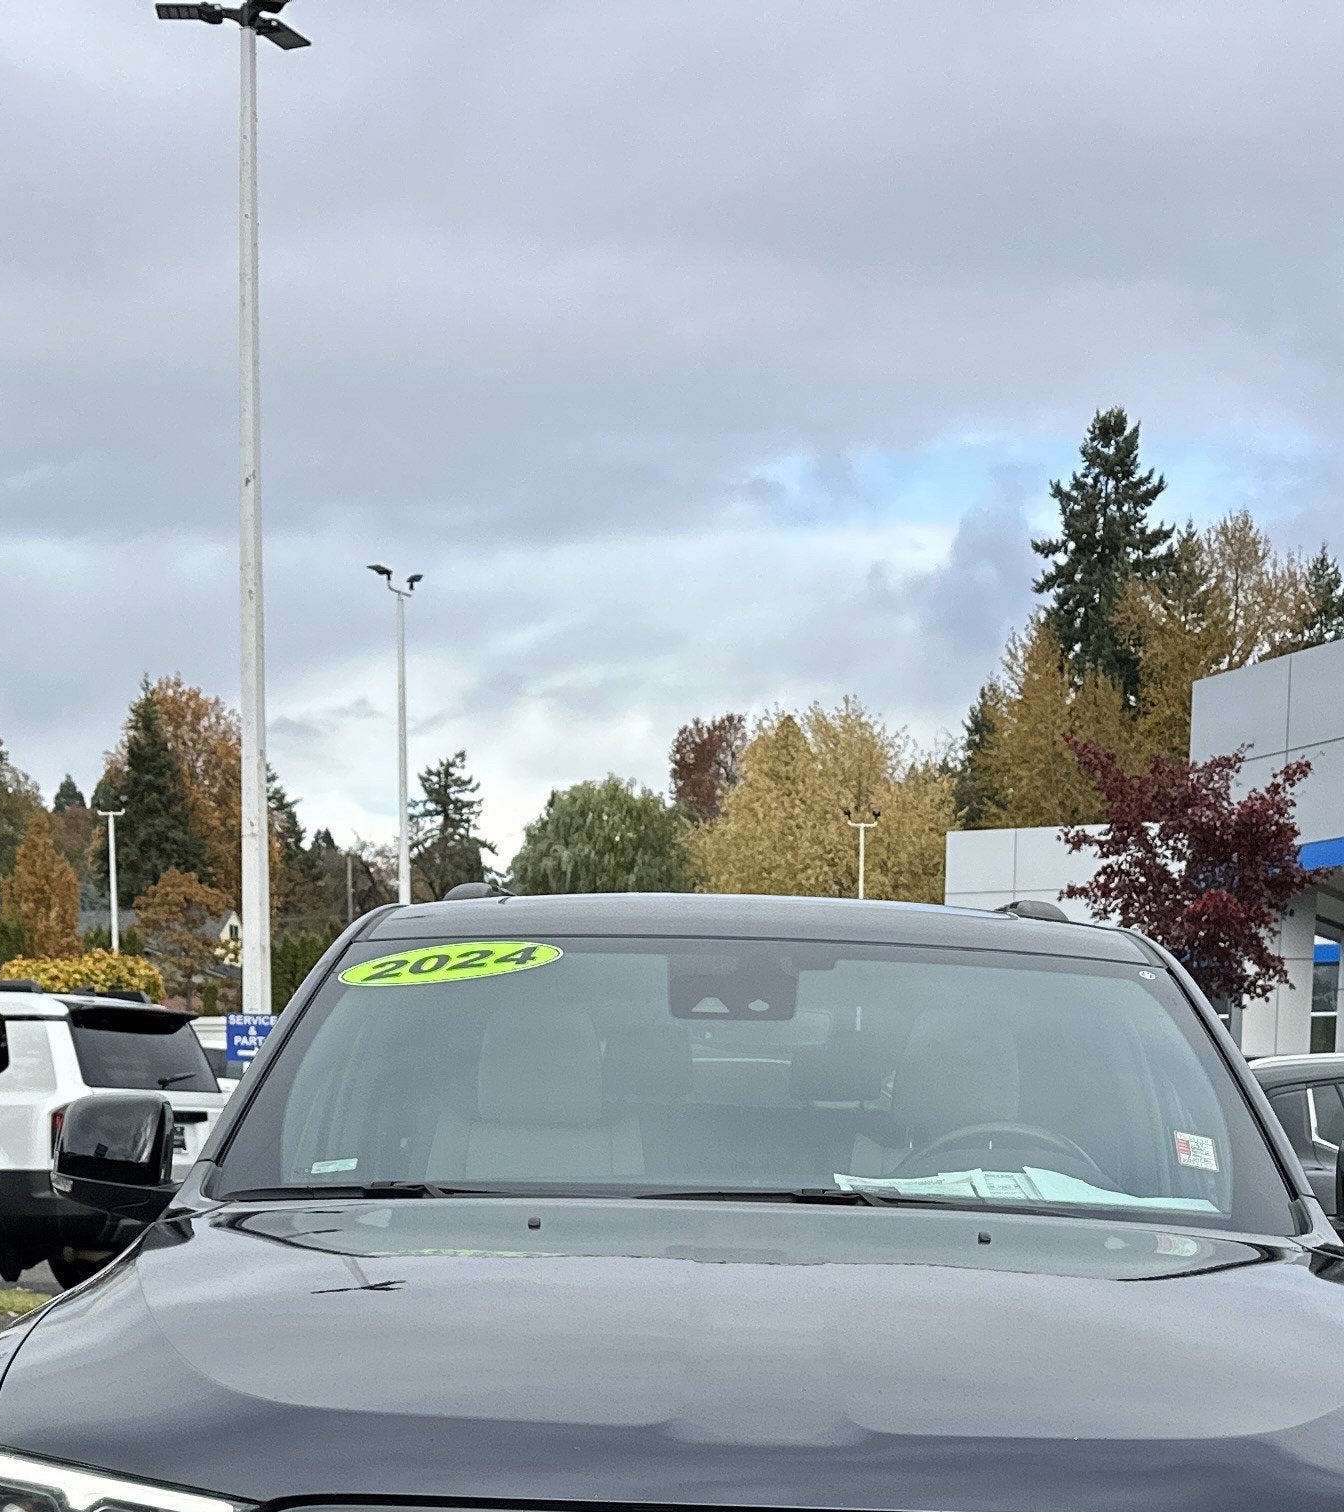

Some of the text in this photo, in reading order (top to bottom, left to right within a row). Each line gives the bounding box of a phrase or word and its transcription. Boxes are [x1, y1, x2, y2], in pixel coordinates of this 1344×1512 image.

[360, 945, 541, 982] 2024
[228, 1014, 278, 1026] SERVICE
[233, 1035, 265, 1047] PART
